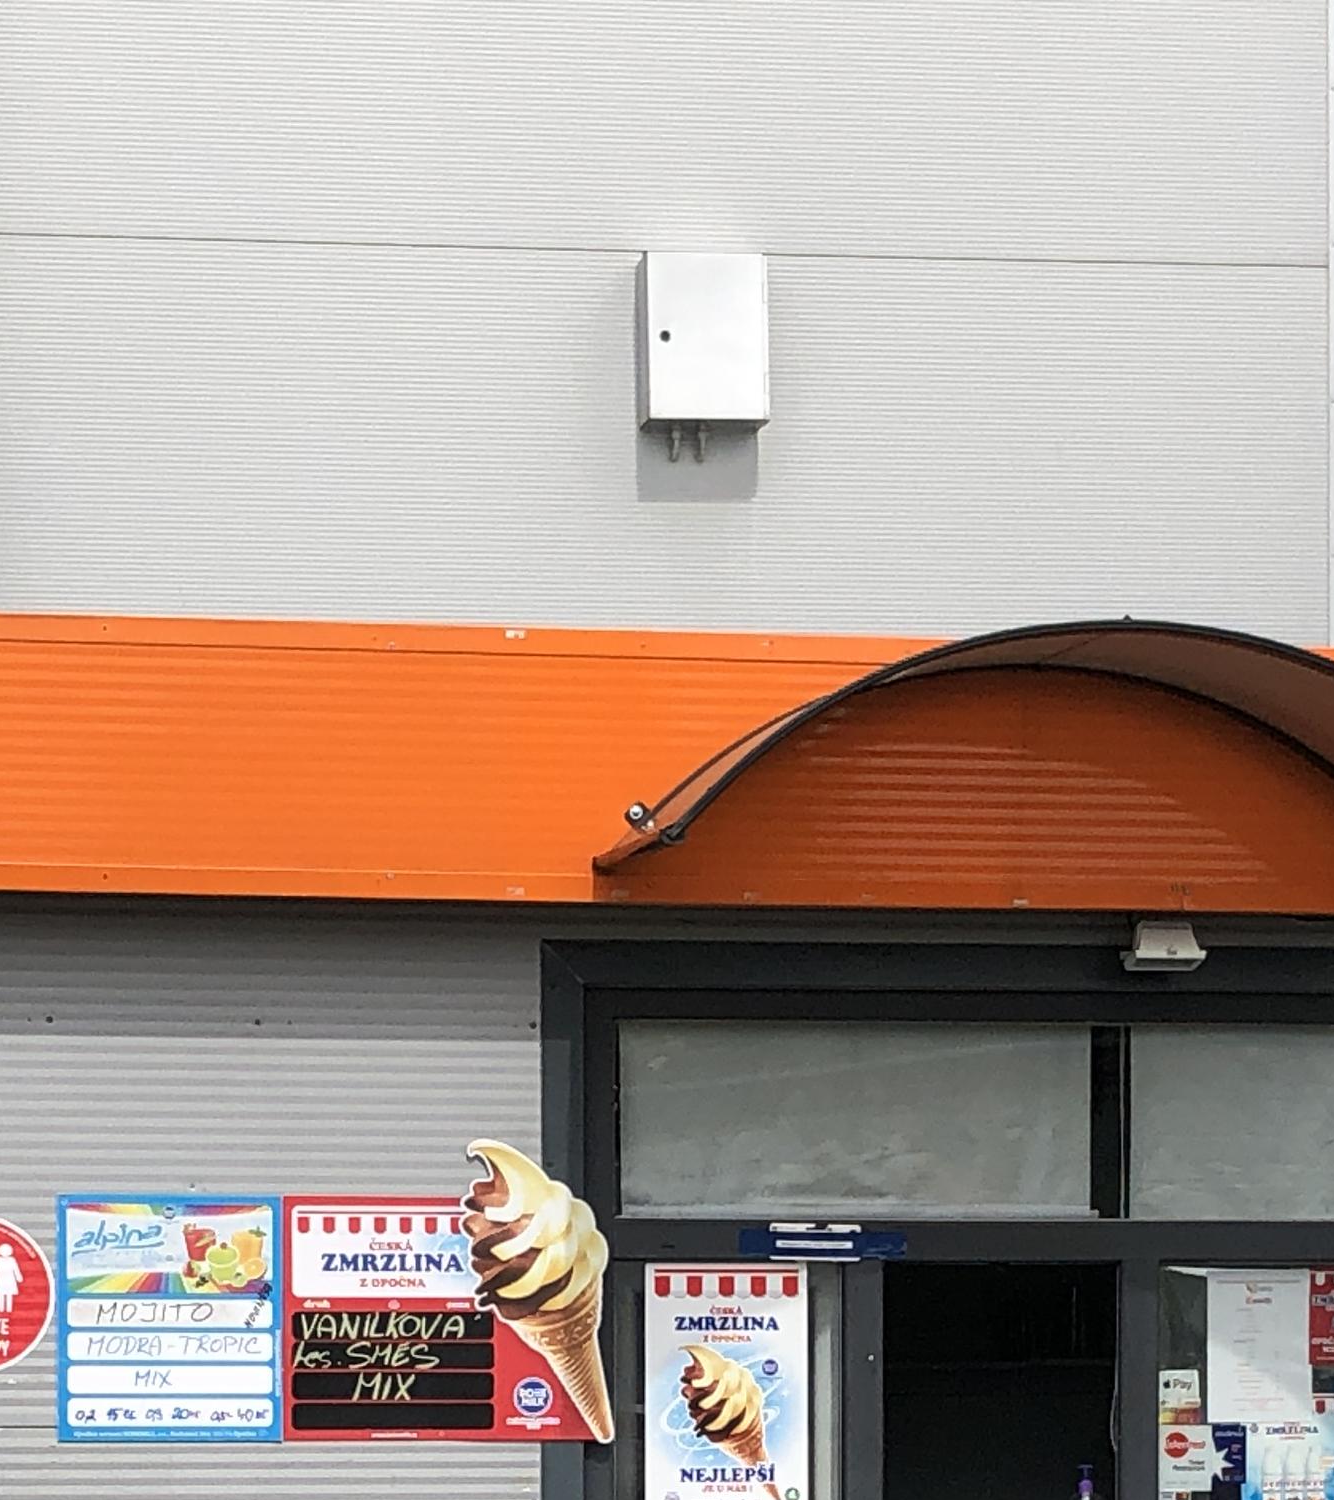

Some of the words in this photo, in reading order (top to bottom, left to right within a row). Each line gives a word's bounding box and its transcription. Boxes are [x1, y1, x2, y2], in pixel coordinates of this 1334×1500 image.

[73, 1219, 163, 1251] alpina
[321, 1253, 465, 1273] ZMRZLINA
[96, 1302, 215, 1326] MOJITO
[674, 1316, 780, 1331] ZMRZLINA
[134, 1370, 174, 1389] MIX
[351, 1372, 417, 1402] MIX
[680, 1463, 776, 1483] NEJLEPŠÍ
